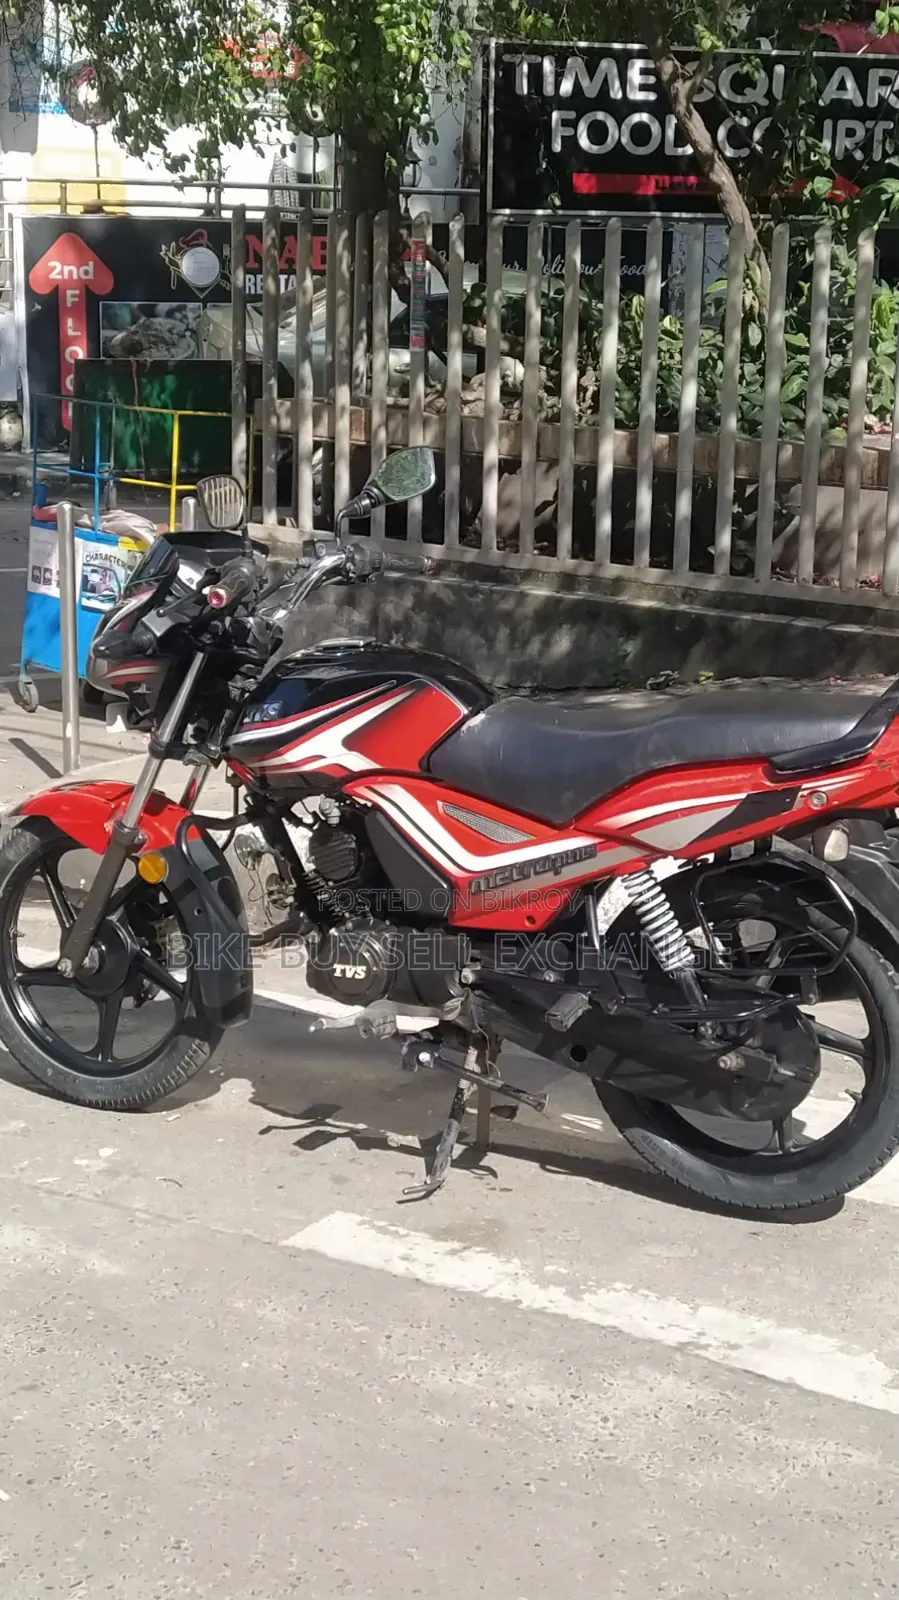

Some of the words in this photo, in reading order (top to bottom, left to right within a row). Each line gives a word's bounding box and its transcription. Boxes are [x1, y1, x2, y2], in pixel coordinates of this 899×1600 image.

[502, 54, 658, 101] TIME
[47, 260, 95, 280] 2nd
[332, 963, 367, 980] TVS
